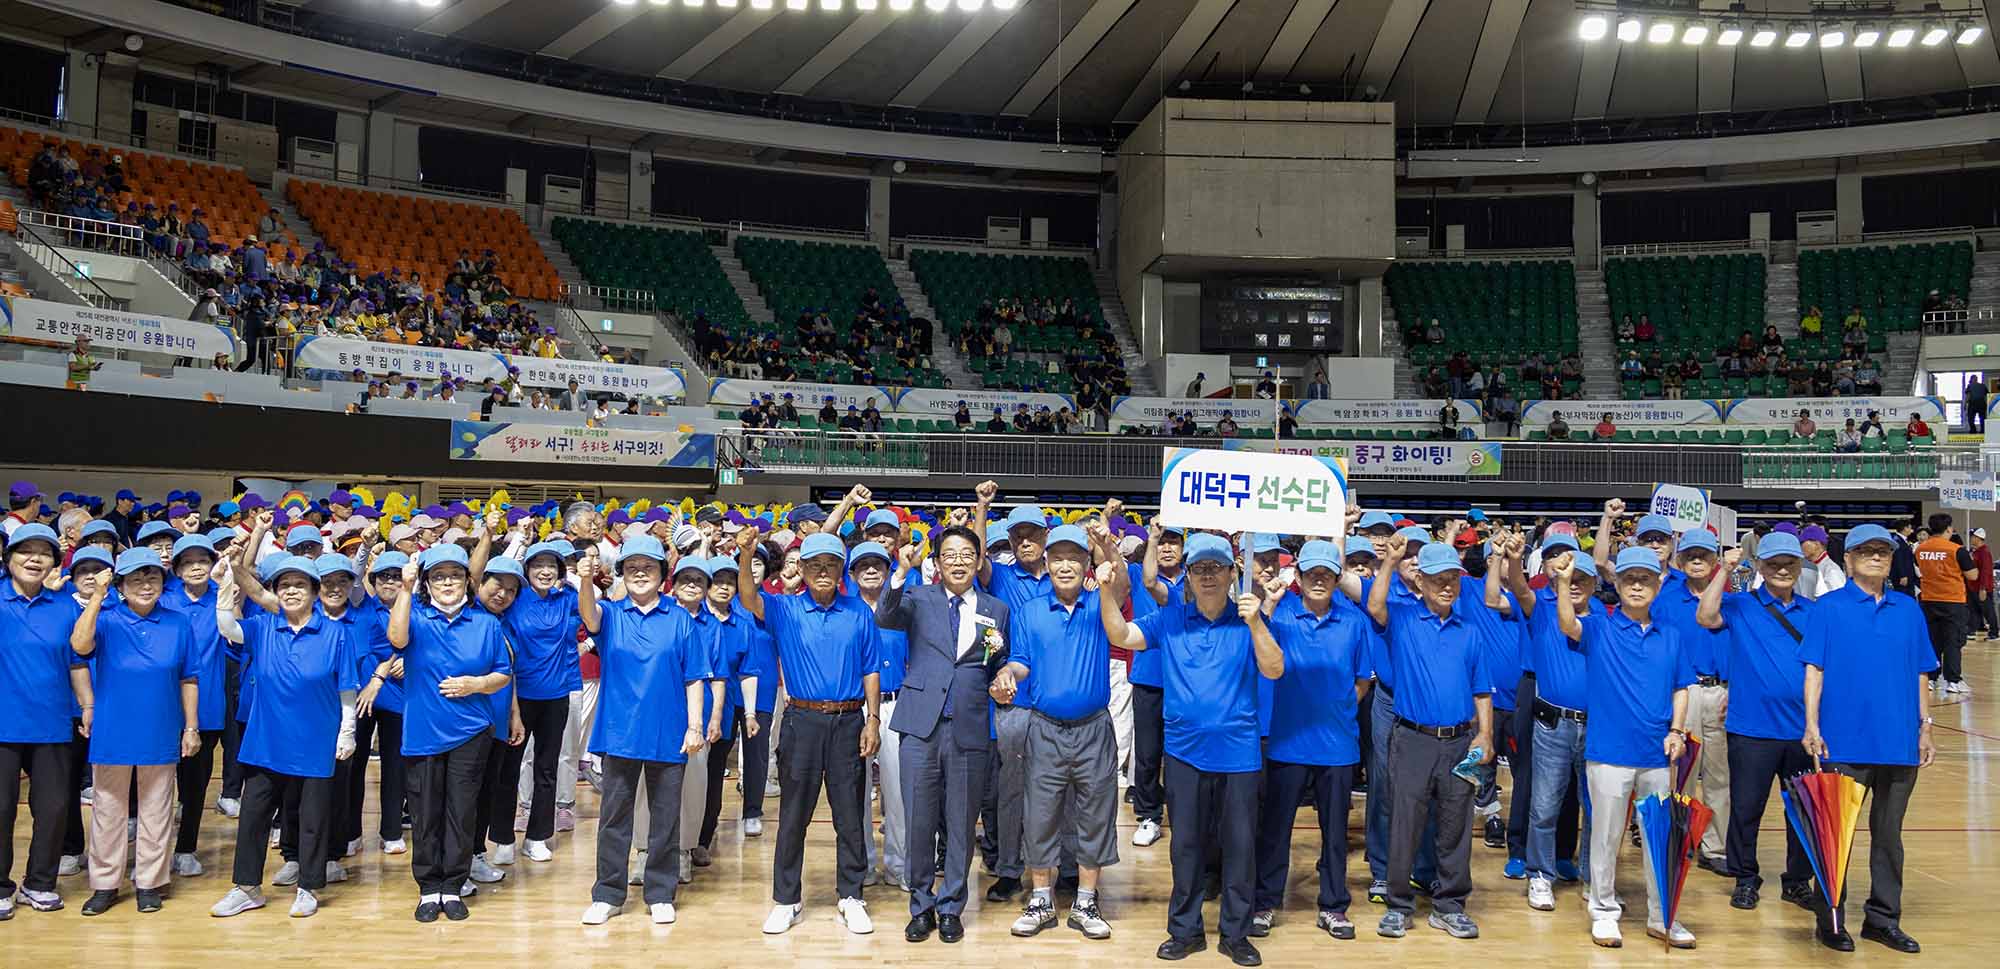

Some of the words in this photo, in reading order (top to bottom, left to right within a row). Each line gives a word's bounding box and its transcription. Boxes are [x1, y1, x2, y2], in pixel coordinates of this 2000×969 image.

[143, 331, 196, 350] 응원합니다
[339, 352, 401, 370] 동방떡집이
[505, 435, 541, 453] 달려라
[545, 437, 573, 452] 서구!
[613, 440, 664, 455] 서구의것!
[1355, 444, 1385, 465] 중구
[1392, 446, 1452, 465] 화이팅!
[1179, 471, 1251, 509] 대덕구
[1257, 475, 1330, 513] 선수단
[1655, 495, 1678, 517] 연합회
[1678, 498, 1703, 522] 선수단
[1919, 551, 1947, 560] STAFF
